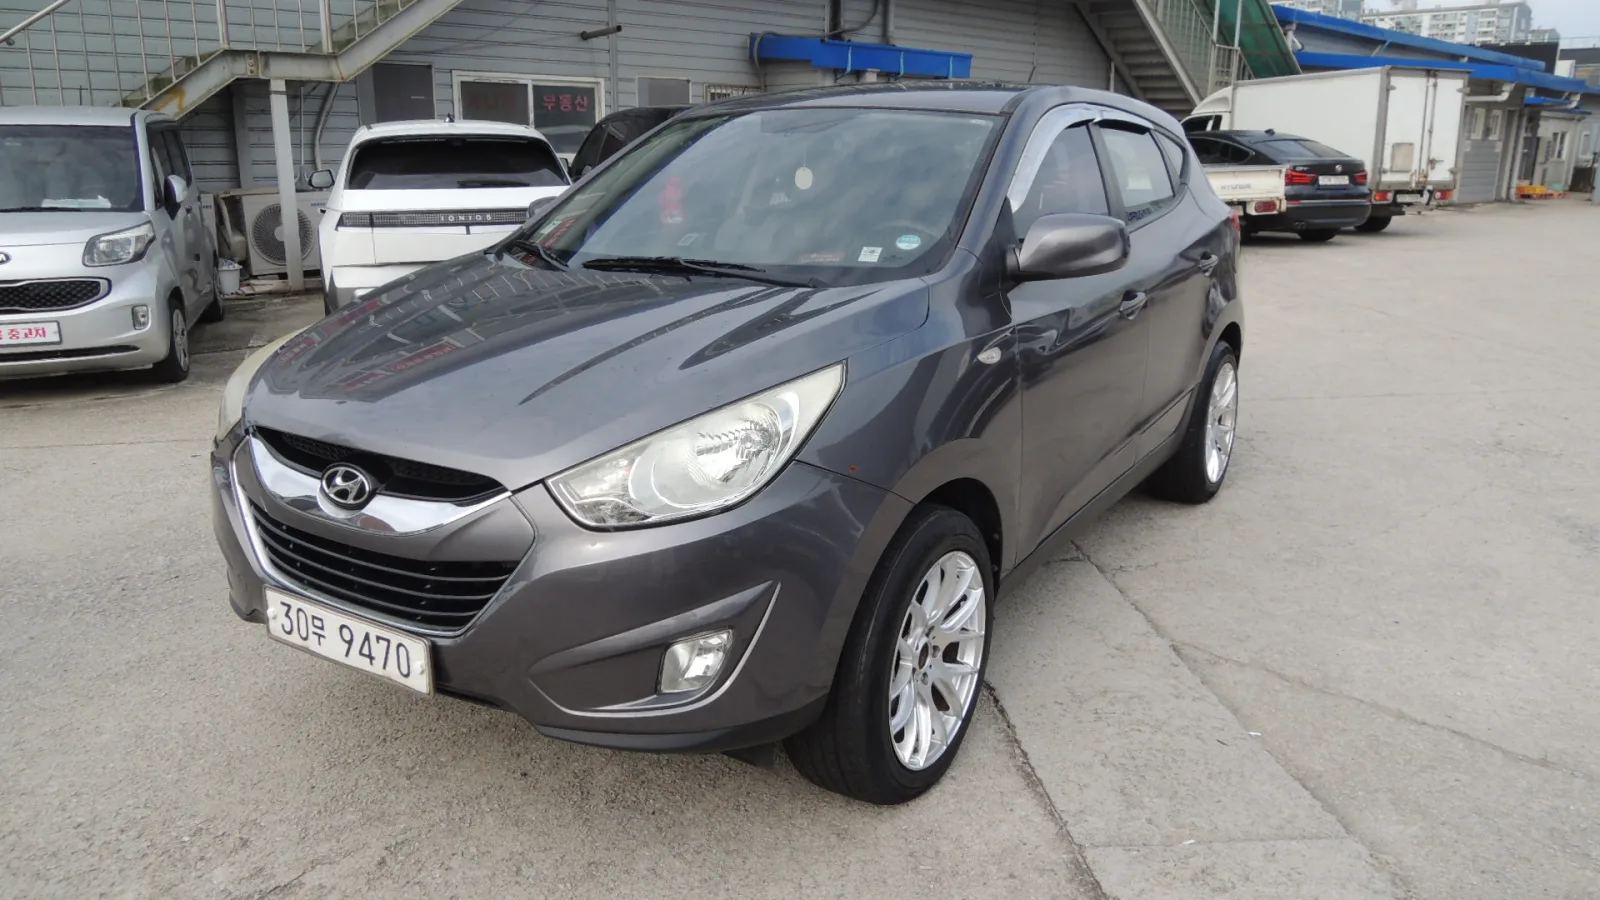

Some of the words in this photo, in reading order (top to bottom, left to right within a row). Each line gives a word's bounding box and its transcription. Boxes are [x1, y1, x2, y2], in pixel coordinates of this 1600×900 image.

[542, 93, 590, 112] 부동산
[8, 327, 47, 340] 중고차
[279, 600, 327, 646] 30무
[339, 623, 411, 678] 9470
